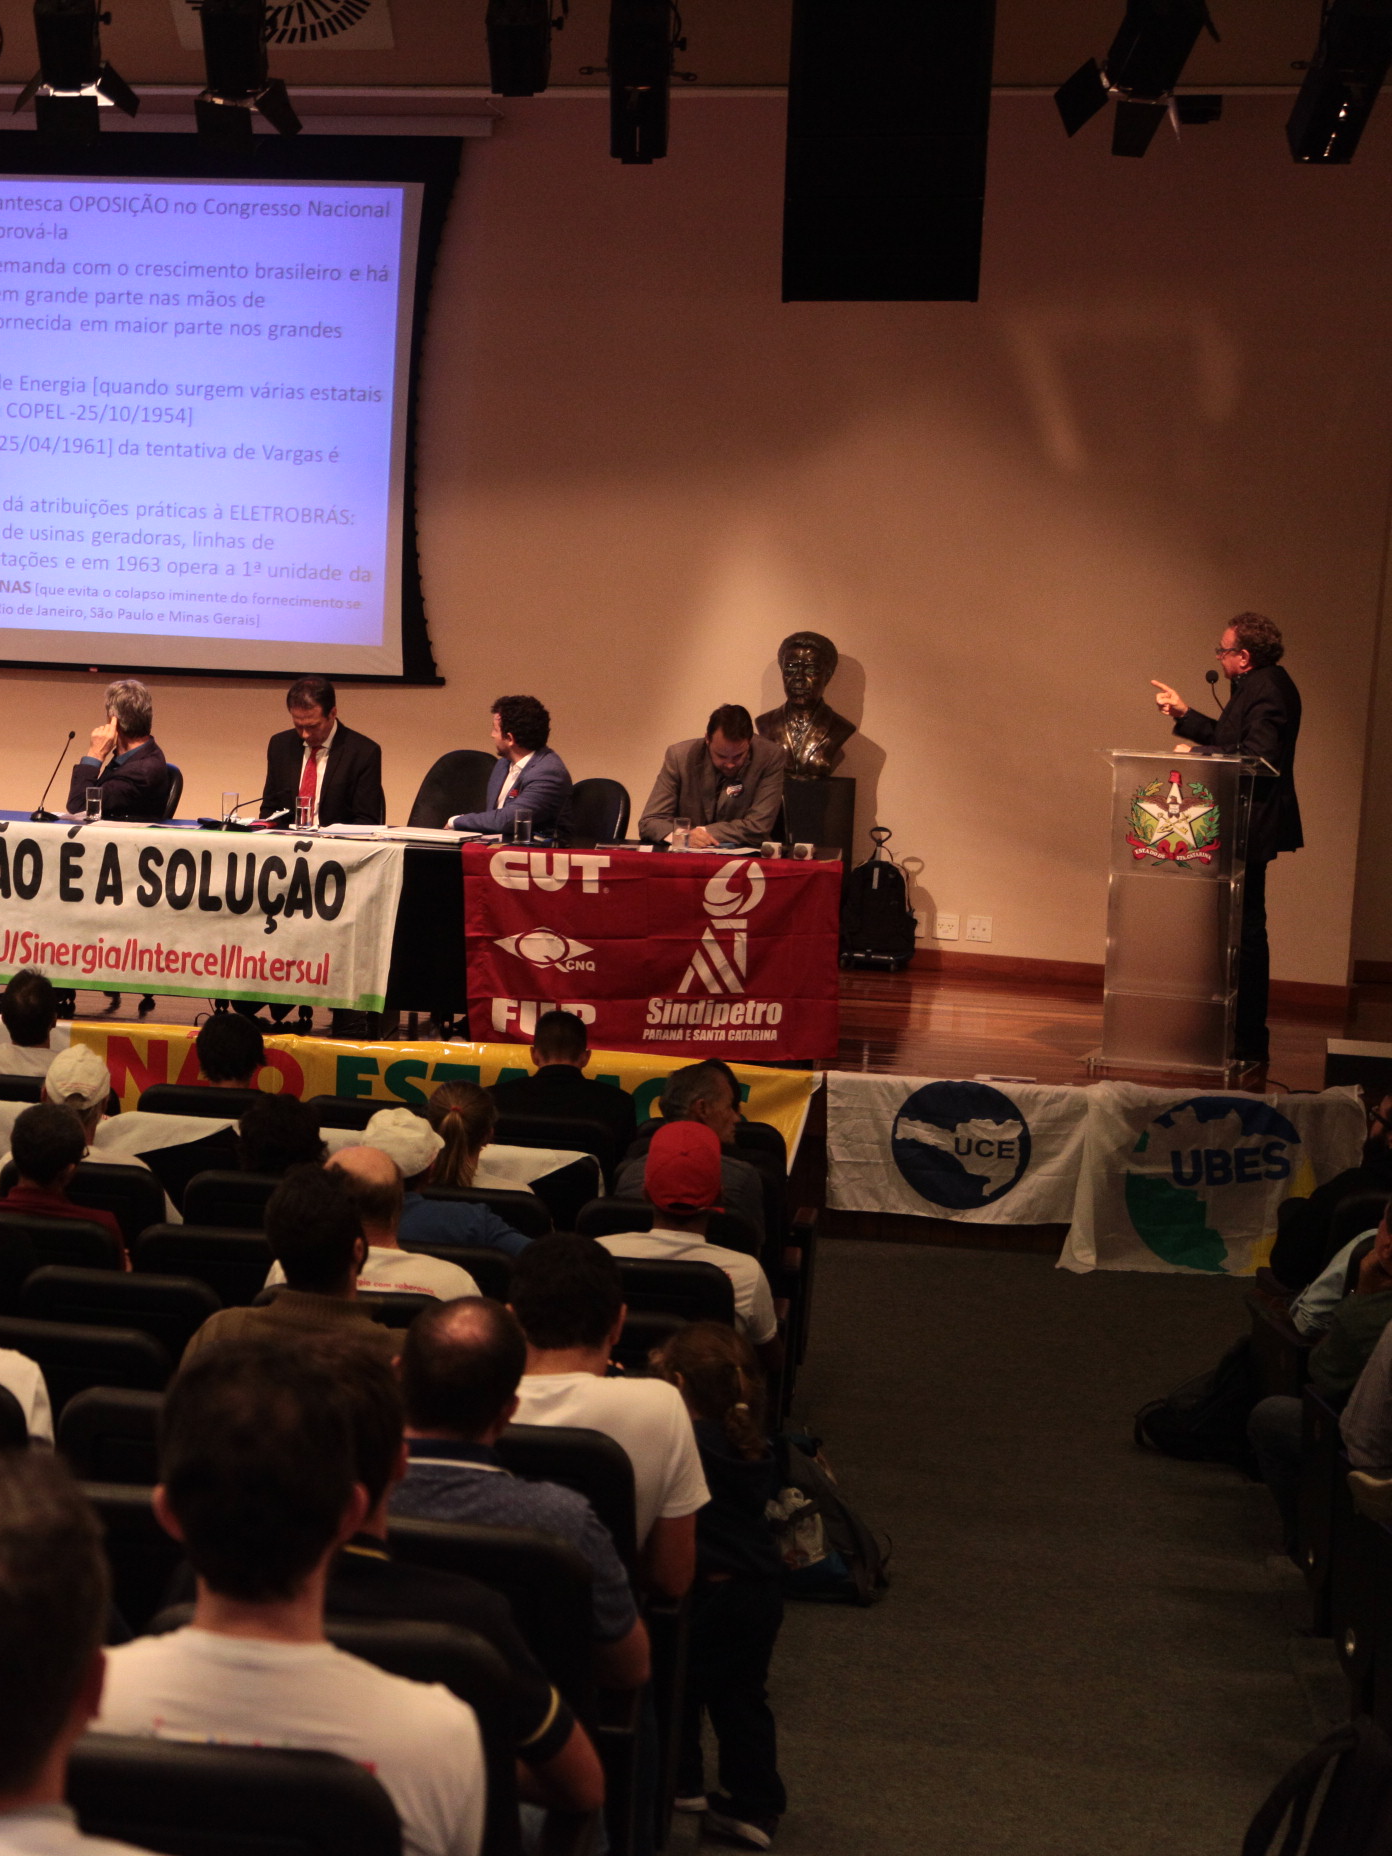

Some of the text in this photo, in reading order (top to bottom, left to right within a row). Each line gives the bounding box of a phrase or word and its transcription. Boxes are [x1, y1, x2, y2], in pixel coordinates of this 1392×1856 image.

[69, 192, 169, 218] OPOSIÇÃO
[173, 201, 197, 214] no
[203, 198, 301, 220] Congresso
[307, 199, 390, 218] Nacional
[72, 262, 111, 275] com
[117, 263, 129, 276] o
[134, 259, 249, 278] crescimento
[255, 262, 342, 281] brasileiro
[348, 268, 360, 281] e
[366, 264, 389, 282] há
[24, 285, 88, 307] grande
[94, 289, 143, 308] parte
[148, 293, 180, 306] nas
[186, 289, 237, 307] mãos
[242, 291, 266, 308] de
[79, 319, 108, 332] em
[114, 316, 168, 334] maior
[173, 319, 223, 338] parte
[229, 323, 262, 336] nos
[267, 320, 342, 342] grandes
[19, 375, 86, 396] Energia
[92, 376, 169, 398] [quando
[175, 383, 244, 401] surgem
[249, 381, 305, 400] várias
[309, 384, 382, 402] estatais
[6, 402, 66, 420] COPEL
[117, 438, 139, 455] da
[145, 440, 227, 458] tentativa
[232, 442, 256, 460] de
[261, 444, 323, 466] Vargas
[328, 445, 340, 463] é
[2, 495, 24, 512] dá
[29, 496, 128, 519] atribuições
[136, 500, 207, 522] práticas
[213, 503, 223, 519] à
[229, 500, 355, 525] ELETROBRÁS:
[1, 523, 24, 540] de
[29, 525, 84, 542] usinas
[91, 526, 186, 550] geradoras,
[192, 530, 246, 548] linhas
[252, 533, 274, 550] de
[64, 556, 75, 569] e
[81, 557, 109, 570] em
[116, 555, 160, 572] 1963
[166, 561, 218, 578] opera
[225, 563, 235, 576] a
[267, 561, 342, 580] unidade
[348, 565, 371, 582] da
[35, 582, 65, 597] [que
[67, 585, 99, 597] evita
[114, 586, 165, 602] colapso
[168, 589, 228, 602] iminente
[230, 592, 248, 603] do
[252, 592, 343, 608] fornecimento
[17, 603, 33, 615] de
[36, 605, 87, 620] Janeiro,
[89, 607, 113, 618] São
[117, 608, 154, 620] Paulo
[169, 610, 209, 623] Minas
[213, 612, 260, 628] Gerais]
[59, 825, 86, 902] É
[95, 842, 123, 906] A
[136, 840, 347, 934] SOLUÇÃO
[489, 850, 611, 894] CUT
[565, 960, 596, 972] CNQ
[646, 997, 783, 1027] Sindipetro
[642, 1028, 778, 1042] PARANÁ E SANTA CATARINA
[953, 1136, 1016, 1160] UCE
[1171, 1141, 1292, 1187] UBES
